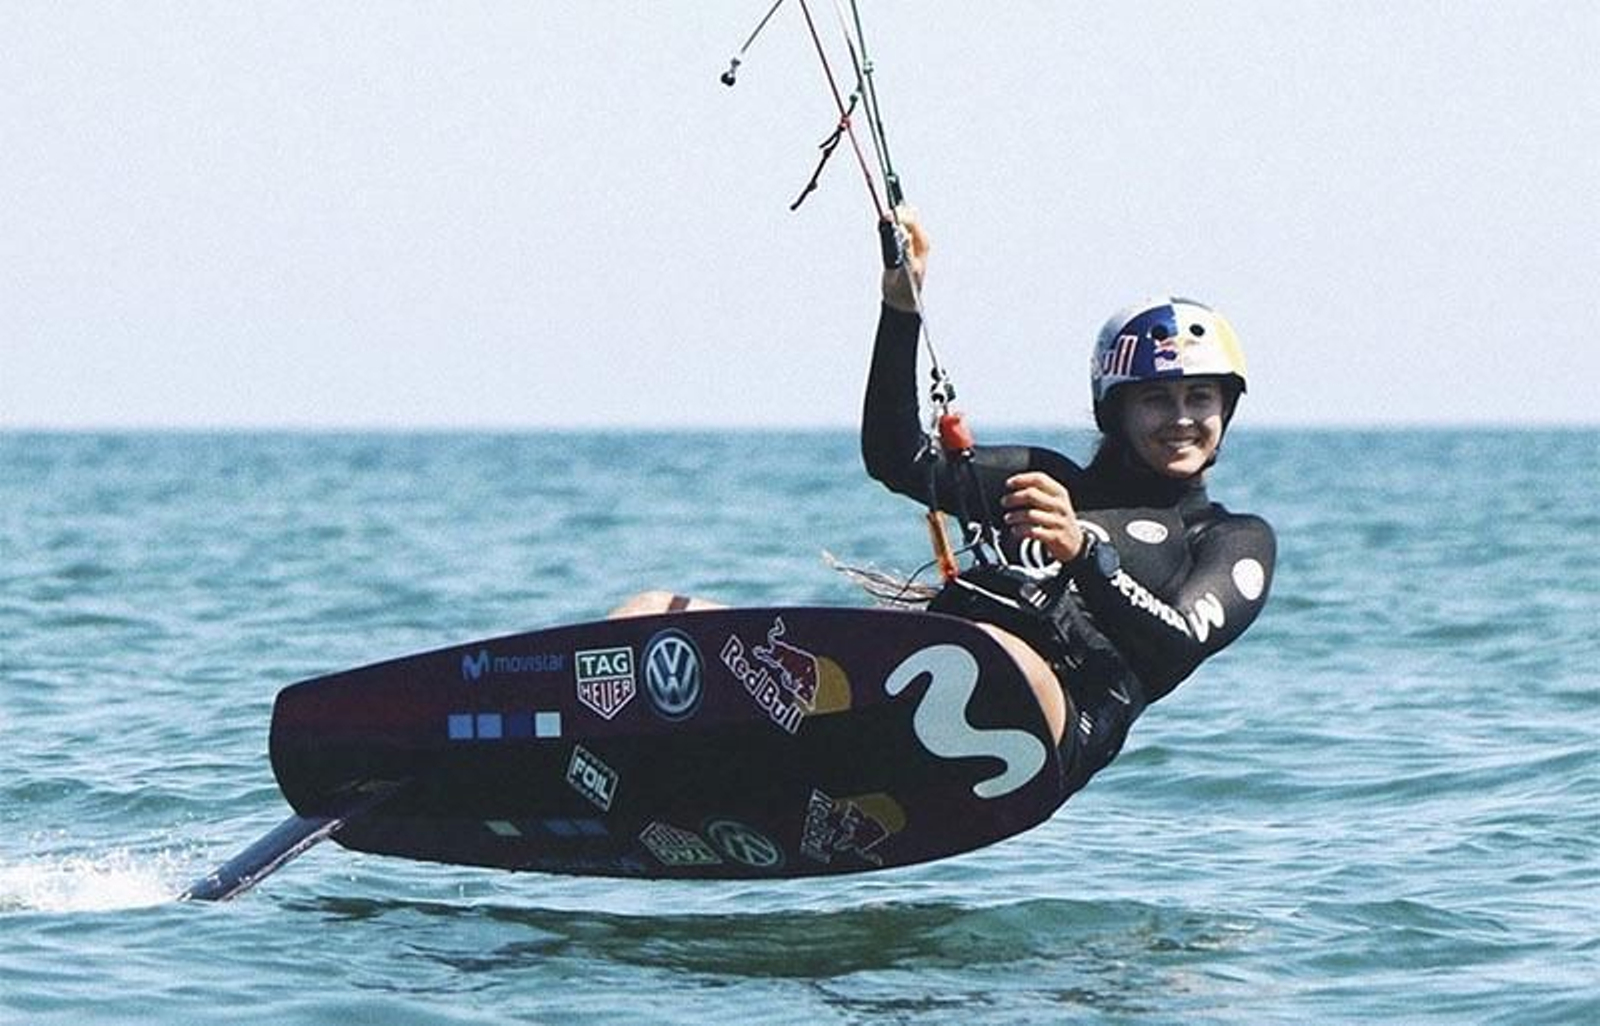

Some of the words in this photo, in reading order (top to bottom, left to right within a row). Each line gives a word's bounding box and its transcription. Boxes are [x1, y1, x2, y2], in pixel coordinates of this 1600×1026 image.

[493, 653, 565, 672] movistar
[581, 653, 628, 675] TAG
[581, 681, 630, 712] HEUER
[572, 756, 609, 801] FOIL
